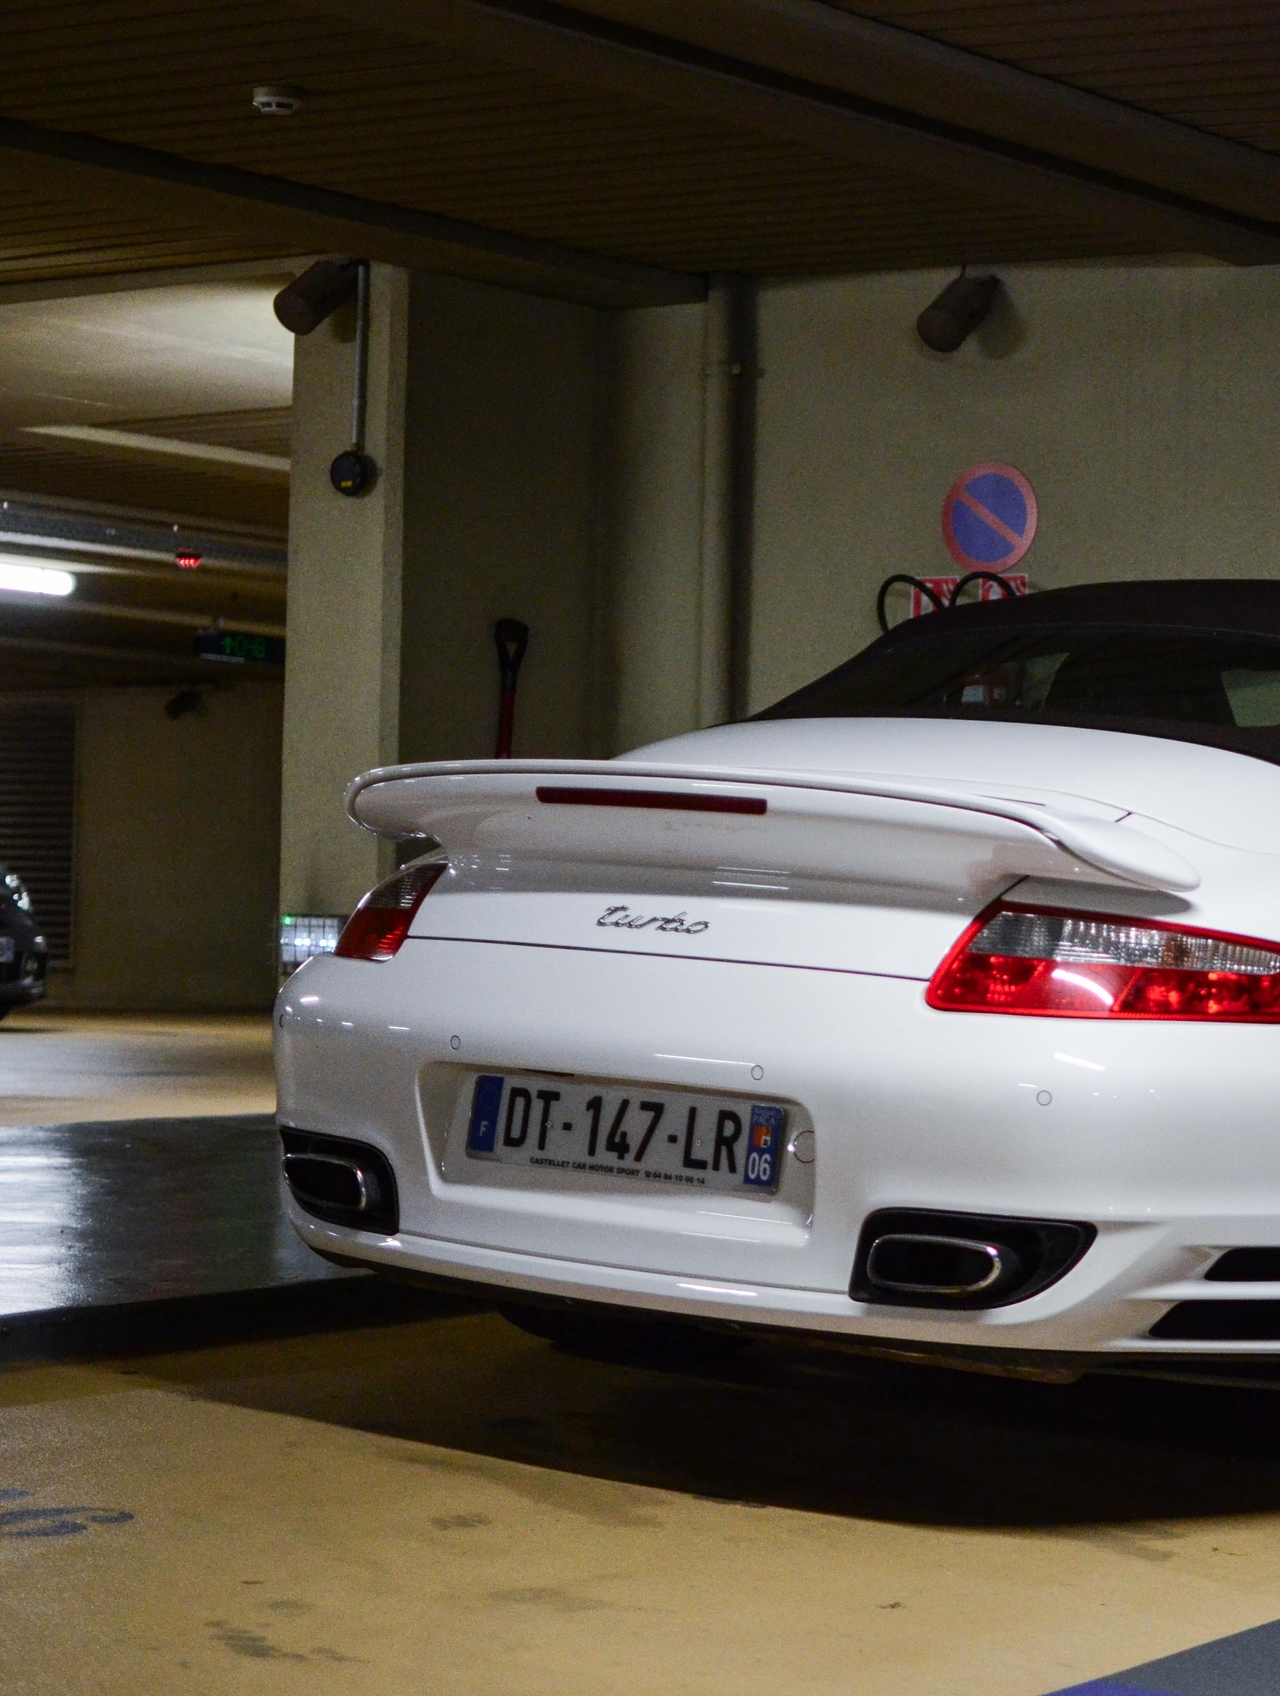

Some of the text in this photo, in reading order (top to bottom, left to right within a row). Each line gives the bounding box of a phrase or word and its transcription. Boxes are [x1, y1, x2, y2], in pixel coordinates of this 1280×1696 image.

[596, 904, 712, 935] turbo
[479, 1120, 489, 1137] F
[502, 1086, 743, 1174] DT-147-LR
[530, 1156, 571, 1168] CASTELLET
[571, 1161, 588, 1170] CAR
[588, 1163, 614, 1174] MOTOR
[616, 1167, 641, 1177] SPORT
[748, 1151, 772, 1182] 06
